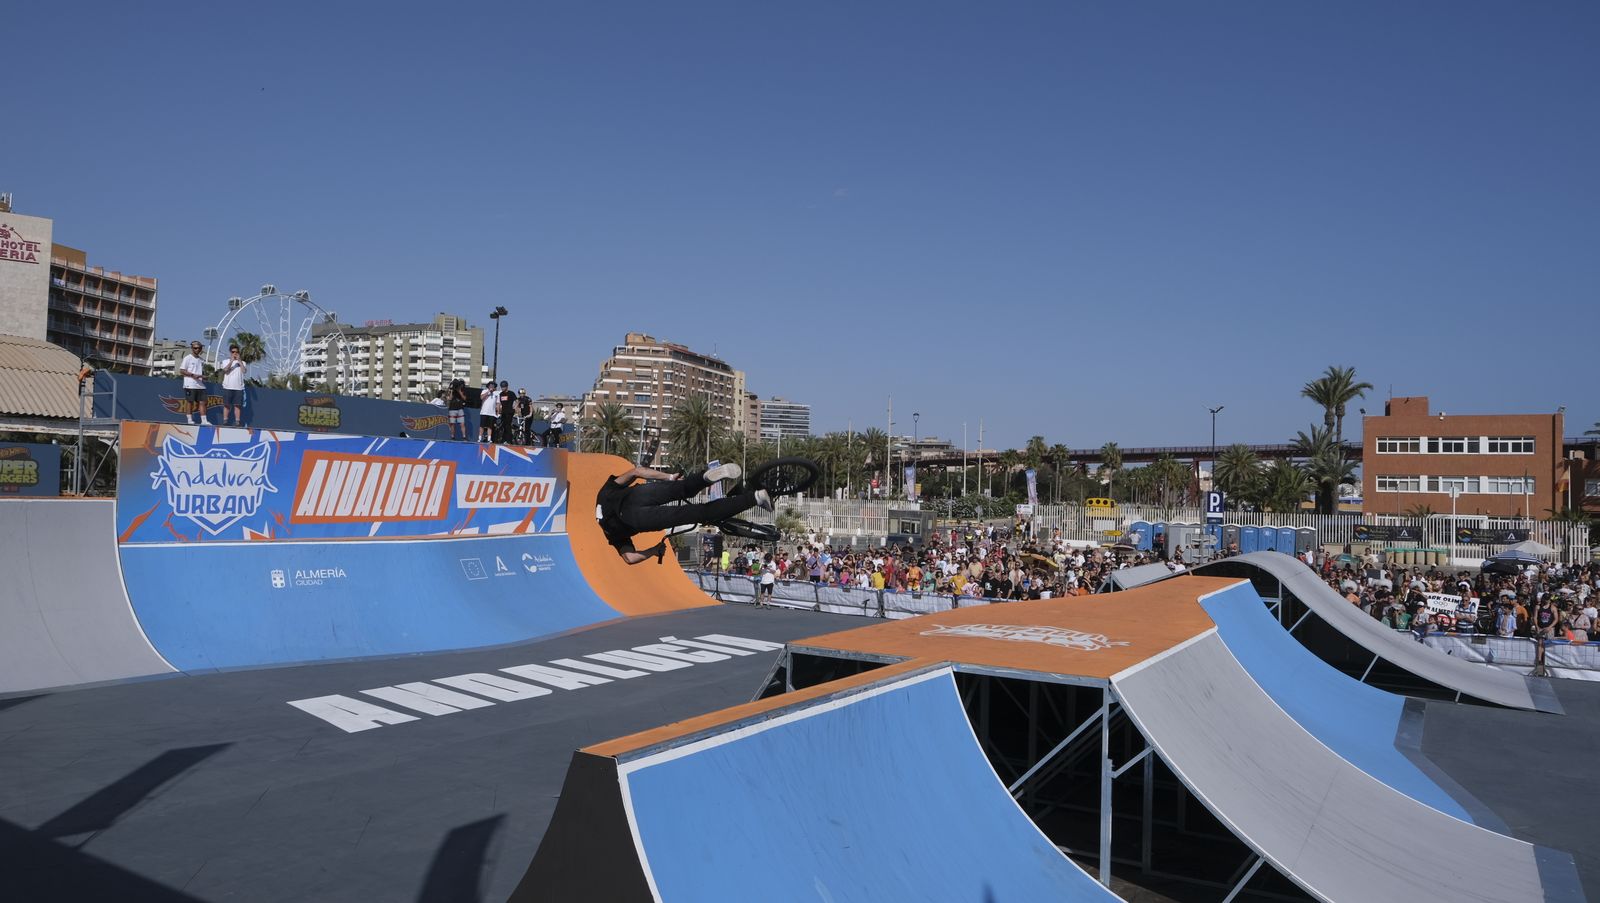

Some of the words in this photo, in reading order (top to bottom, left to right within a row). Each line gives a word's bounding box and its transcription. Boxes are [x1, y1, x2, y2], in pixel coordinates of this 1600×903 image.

[1, 240, 41, 253] HOTEL
[299, 405, 340, 419] SUPER
[299, 417, 340, 427] CHARGERS
[414, 418, 430, 430] HOT
[151, 457, 278, 493] Andalucía
[296, 458, 449, 517] ANDALUCÍA
[464, 481, 550, 503] URBAN
[175, 494, 255, 514] URBAN
[295, 567, 347, 579] ALMERÍA
[286, 633, 786, 734] ANDALUCÍA
